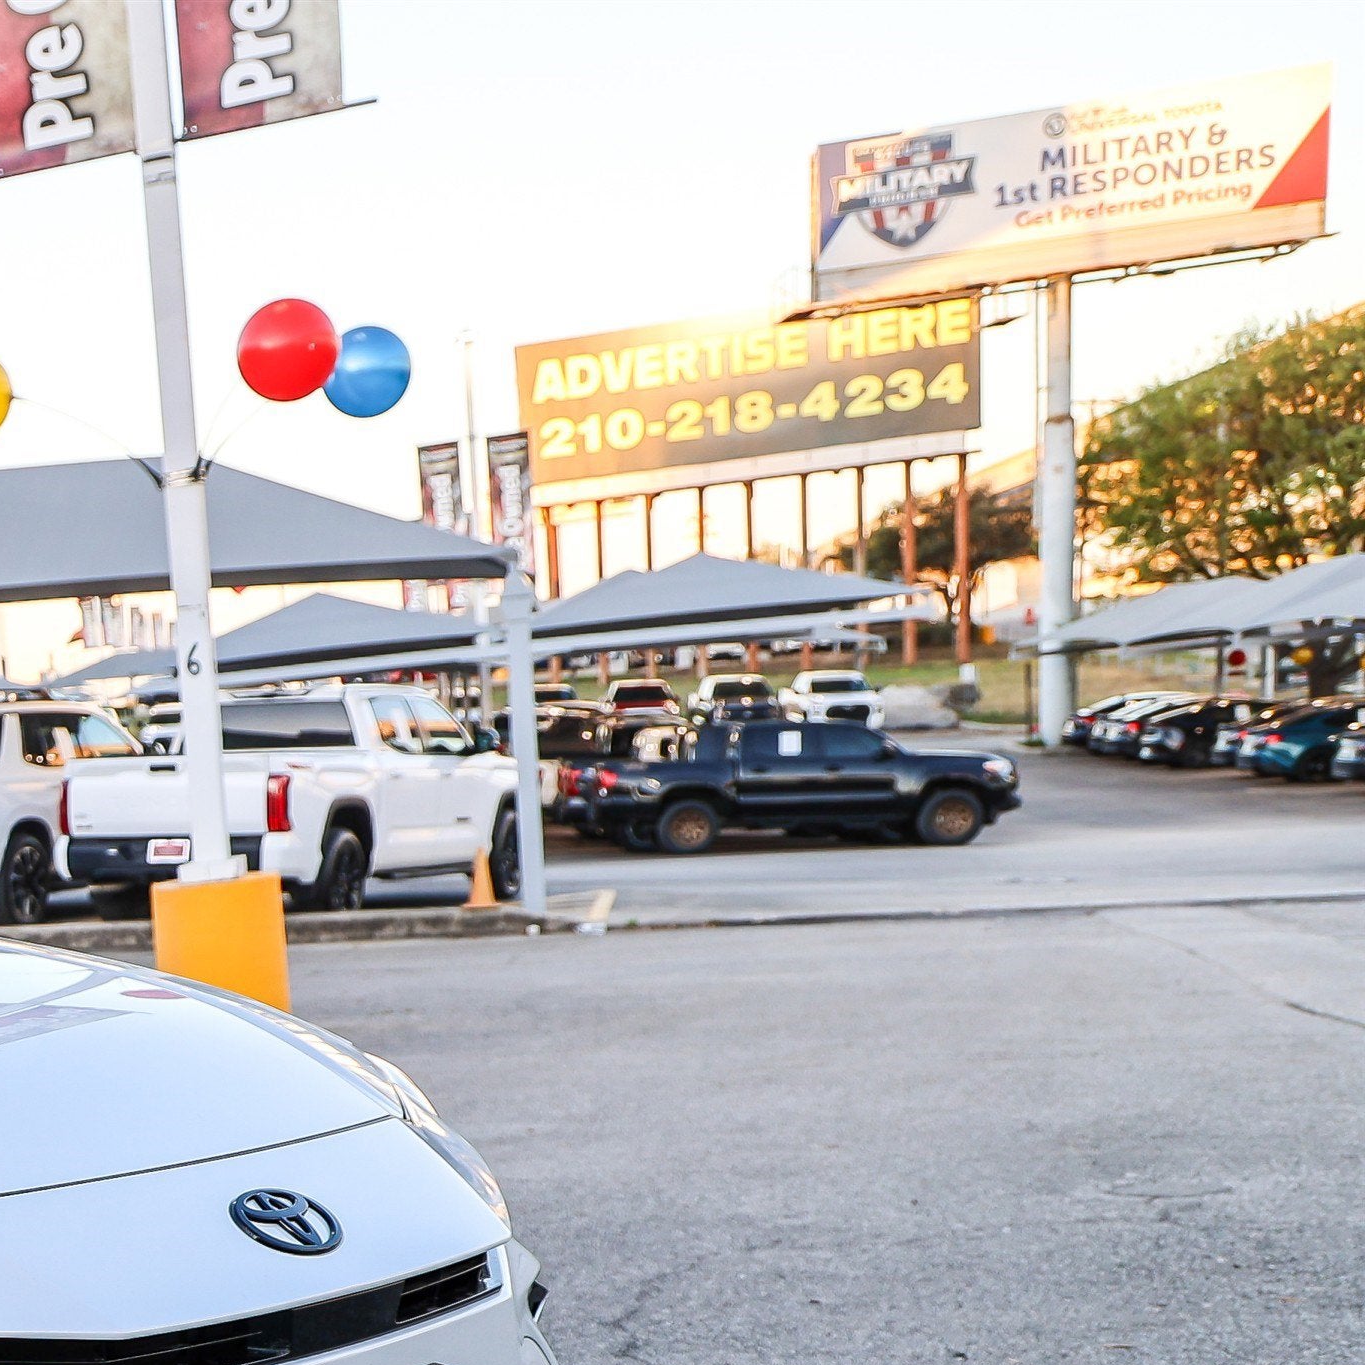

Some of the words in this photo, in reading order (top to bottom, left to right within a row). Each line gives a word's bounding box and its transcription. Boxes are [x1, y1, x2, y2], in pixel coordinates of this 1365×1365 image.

[22, 22, 95, 152] Pre
[1041, 125, 1197, 172] MILITARY
[1207, 122, 1229, 147] &
[837, 159, 971, 203] MILITARY
[995, 182, 1039, 208] 1st
[1049, 144, 1276, 200] RESPONDERS
[1014, 208, 1054, 228] Get
[1061, 192, 1166, 223] Preferred
[1172, 182, 1253, 206] Pricing
[532, 321, 810, 405] ADVERTISE
[827, 297, 972, 363] HERE
[538, 362, 970, 460] 210-218-4234
[187, 640, 200, 676] 6
